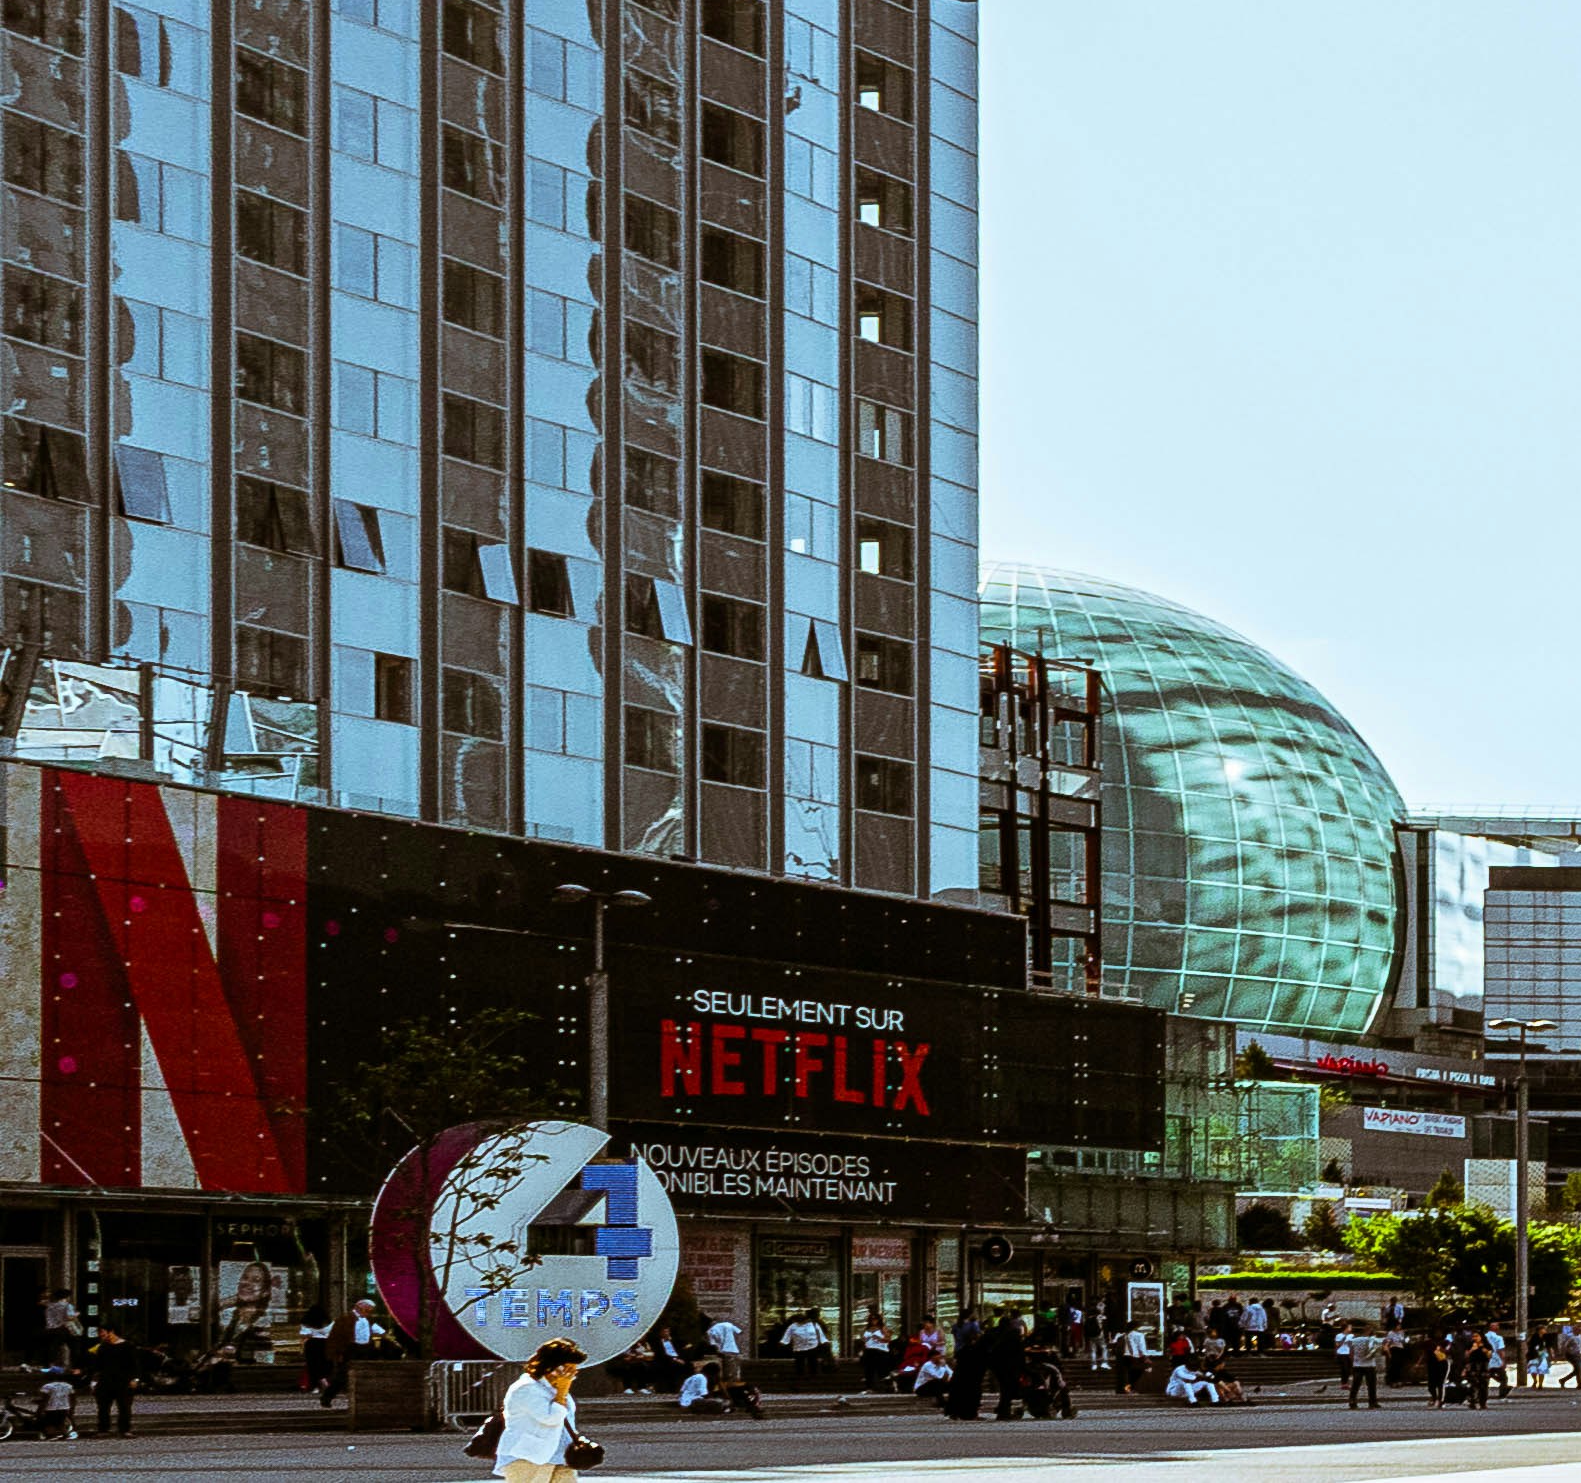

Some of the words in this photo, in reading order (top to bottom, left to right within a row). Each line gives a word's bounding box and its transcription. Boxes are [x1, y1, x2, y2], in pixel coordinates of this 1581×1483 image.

[693, 989, 852, 1026] SEULEMENT
[855, 1006, 905, 1032] SUR
[660, 1018, 931, 1117] NETFLIX
[1366, 1109, 1420, 1126] VAPIANO
[630, 1142, 761, 1171] NOUVEAUX
[765, 1145, 870, 1177] ÉPISODES
[655, 1169, 751, 1196] ONIBLES
[755, 1176, 898, 1202] MAINTENANT
[215, 1221, 290, 1237] SEPHOR
[464, 1288, 641, 1328] TEMPS
